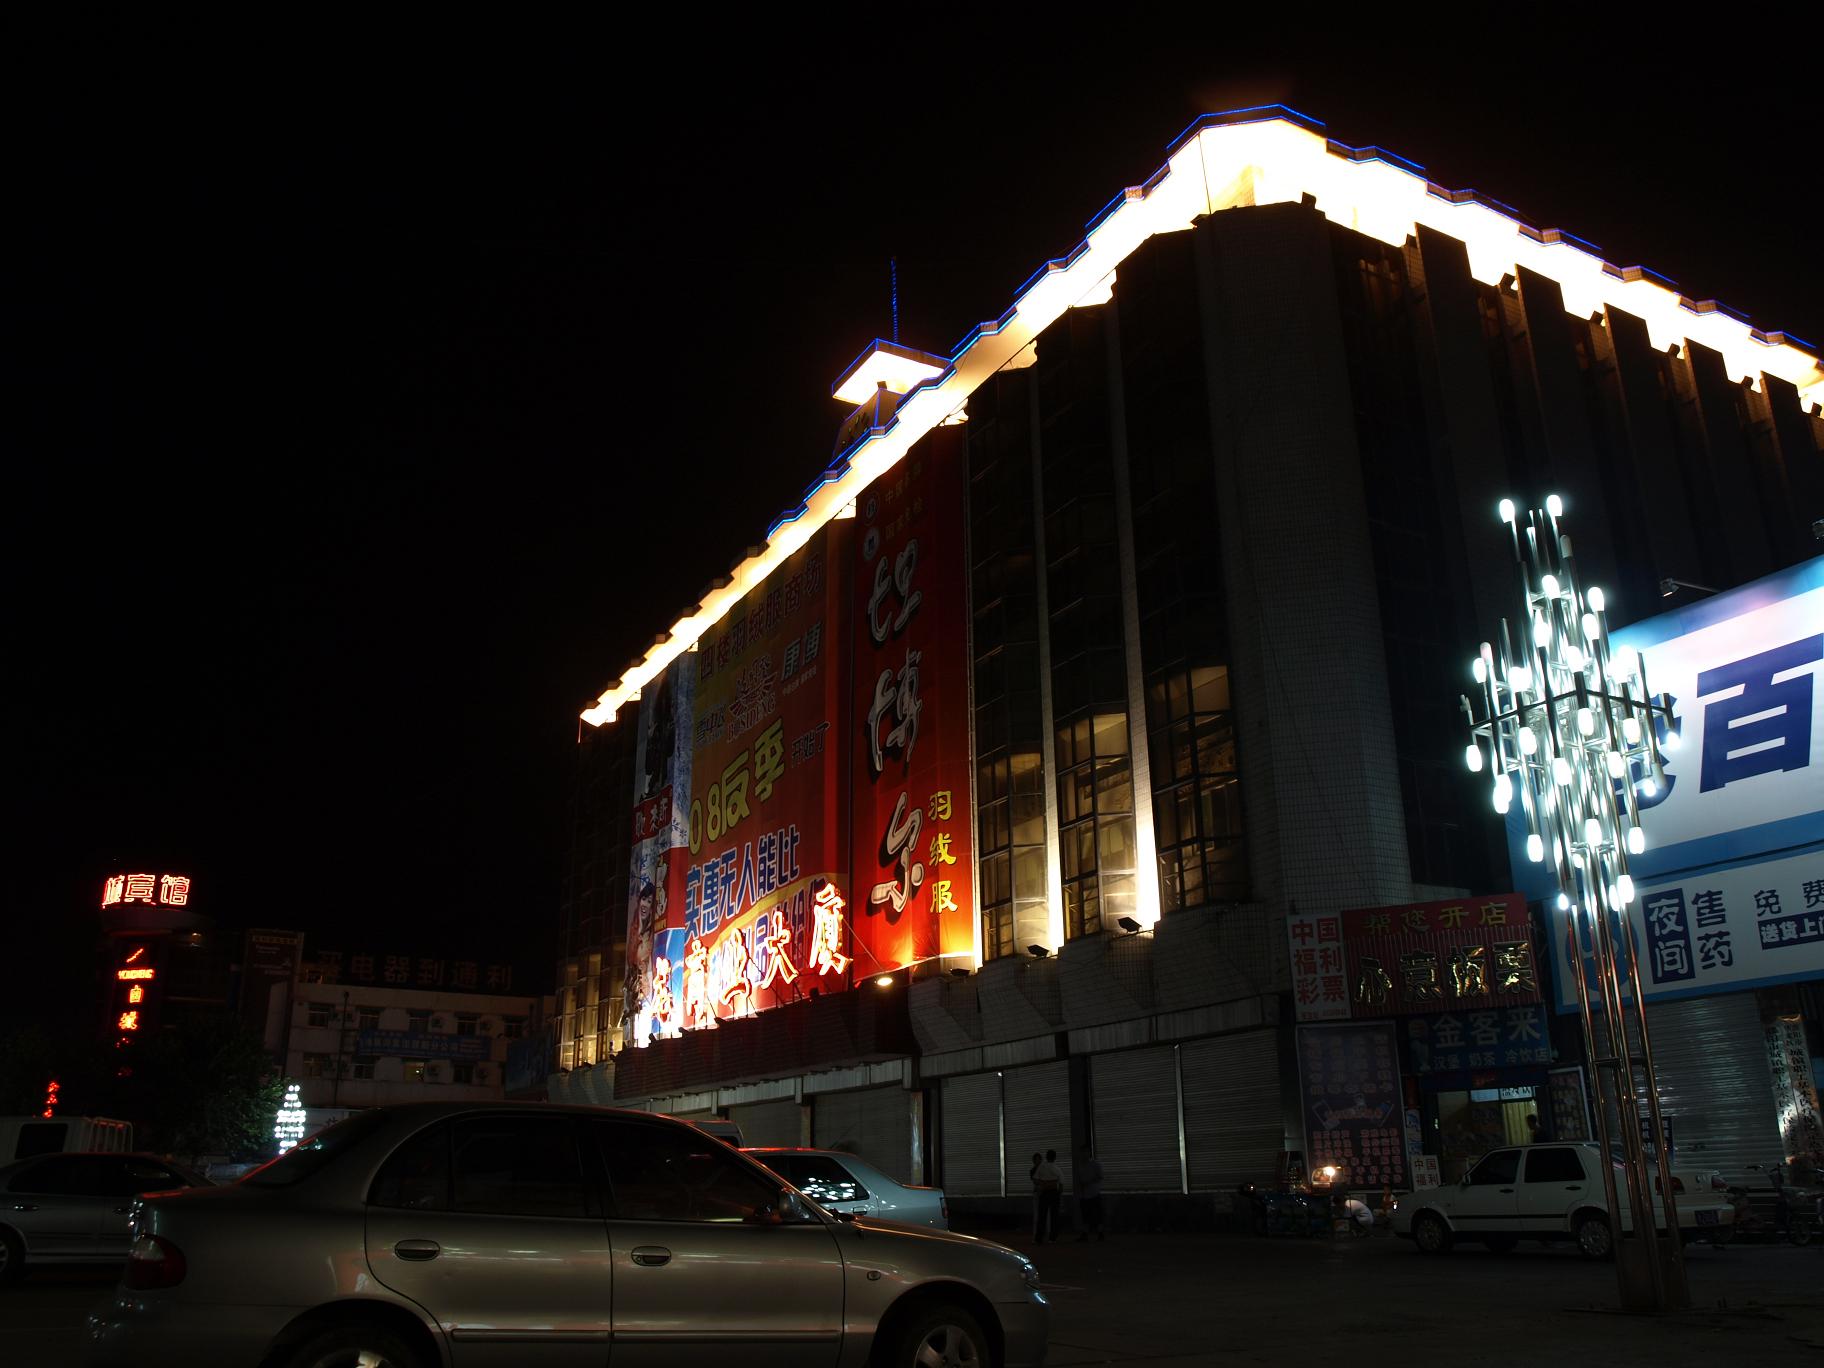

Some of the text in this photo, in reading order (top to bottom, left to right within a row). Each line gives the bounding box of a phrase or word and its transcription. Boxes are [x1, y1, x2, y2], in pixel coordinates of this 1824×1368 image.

[928, 791, 958, 914] 羽绒服
[684, 823, 800, 945] 实惠无人能比
[1291, 917, 1341, 946] 中国
[1364, 902, 1509, 935] 帮您开店
[1294, 946, 1344, 976] 福利
[1296, 975, 1346, 1005] 彩票
[1432, 1005, 1542, 1049] 金客来
[1469, 1051, 1496, 1067] 奶茶
